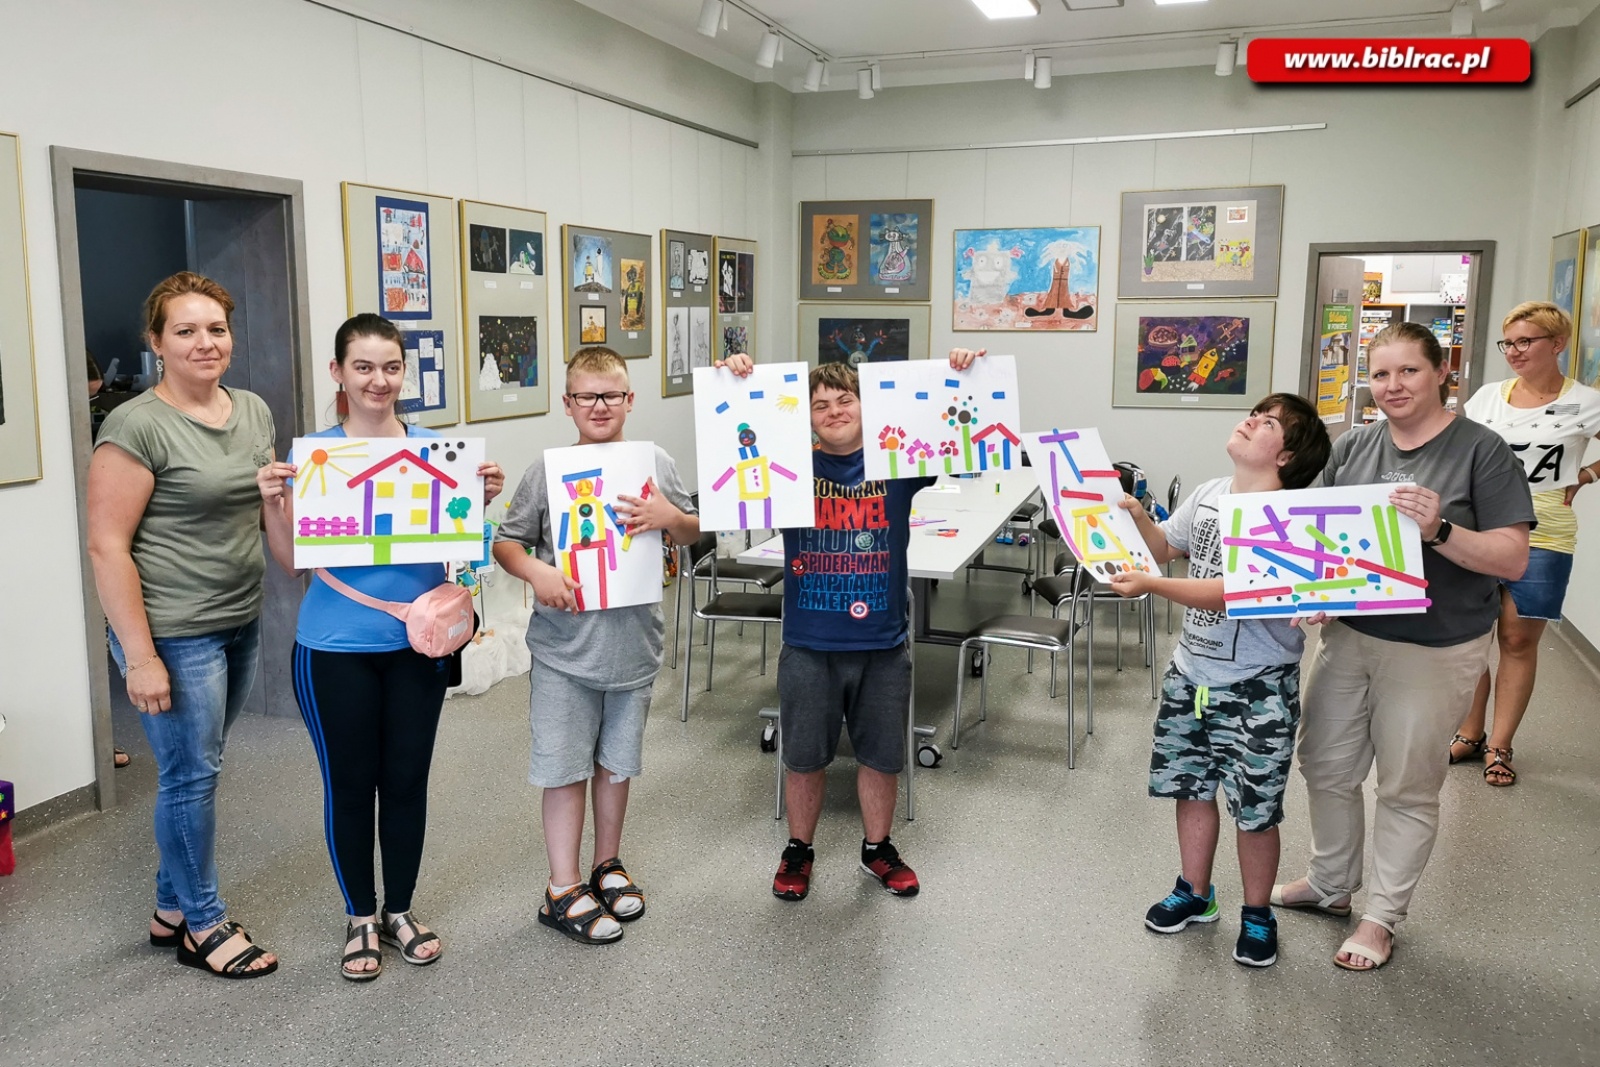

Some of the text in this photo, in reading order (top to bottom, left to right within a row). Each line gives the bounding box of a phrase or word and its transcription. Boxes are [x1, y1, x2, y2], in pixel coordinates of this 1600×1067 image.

[799, 527, 890, 554] HULK
[799, 552, 890, 574] SPIDER-MAN
[799, 572, 889, 593] CAPTAIN
[798, 591, 888, 612] AMERICA
